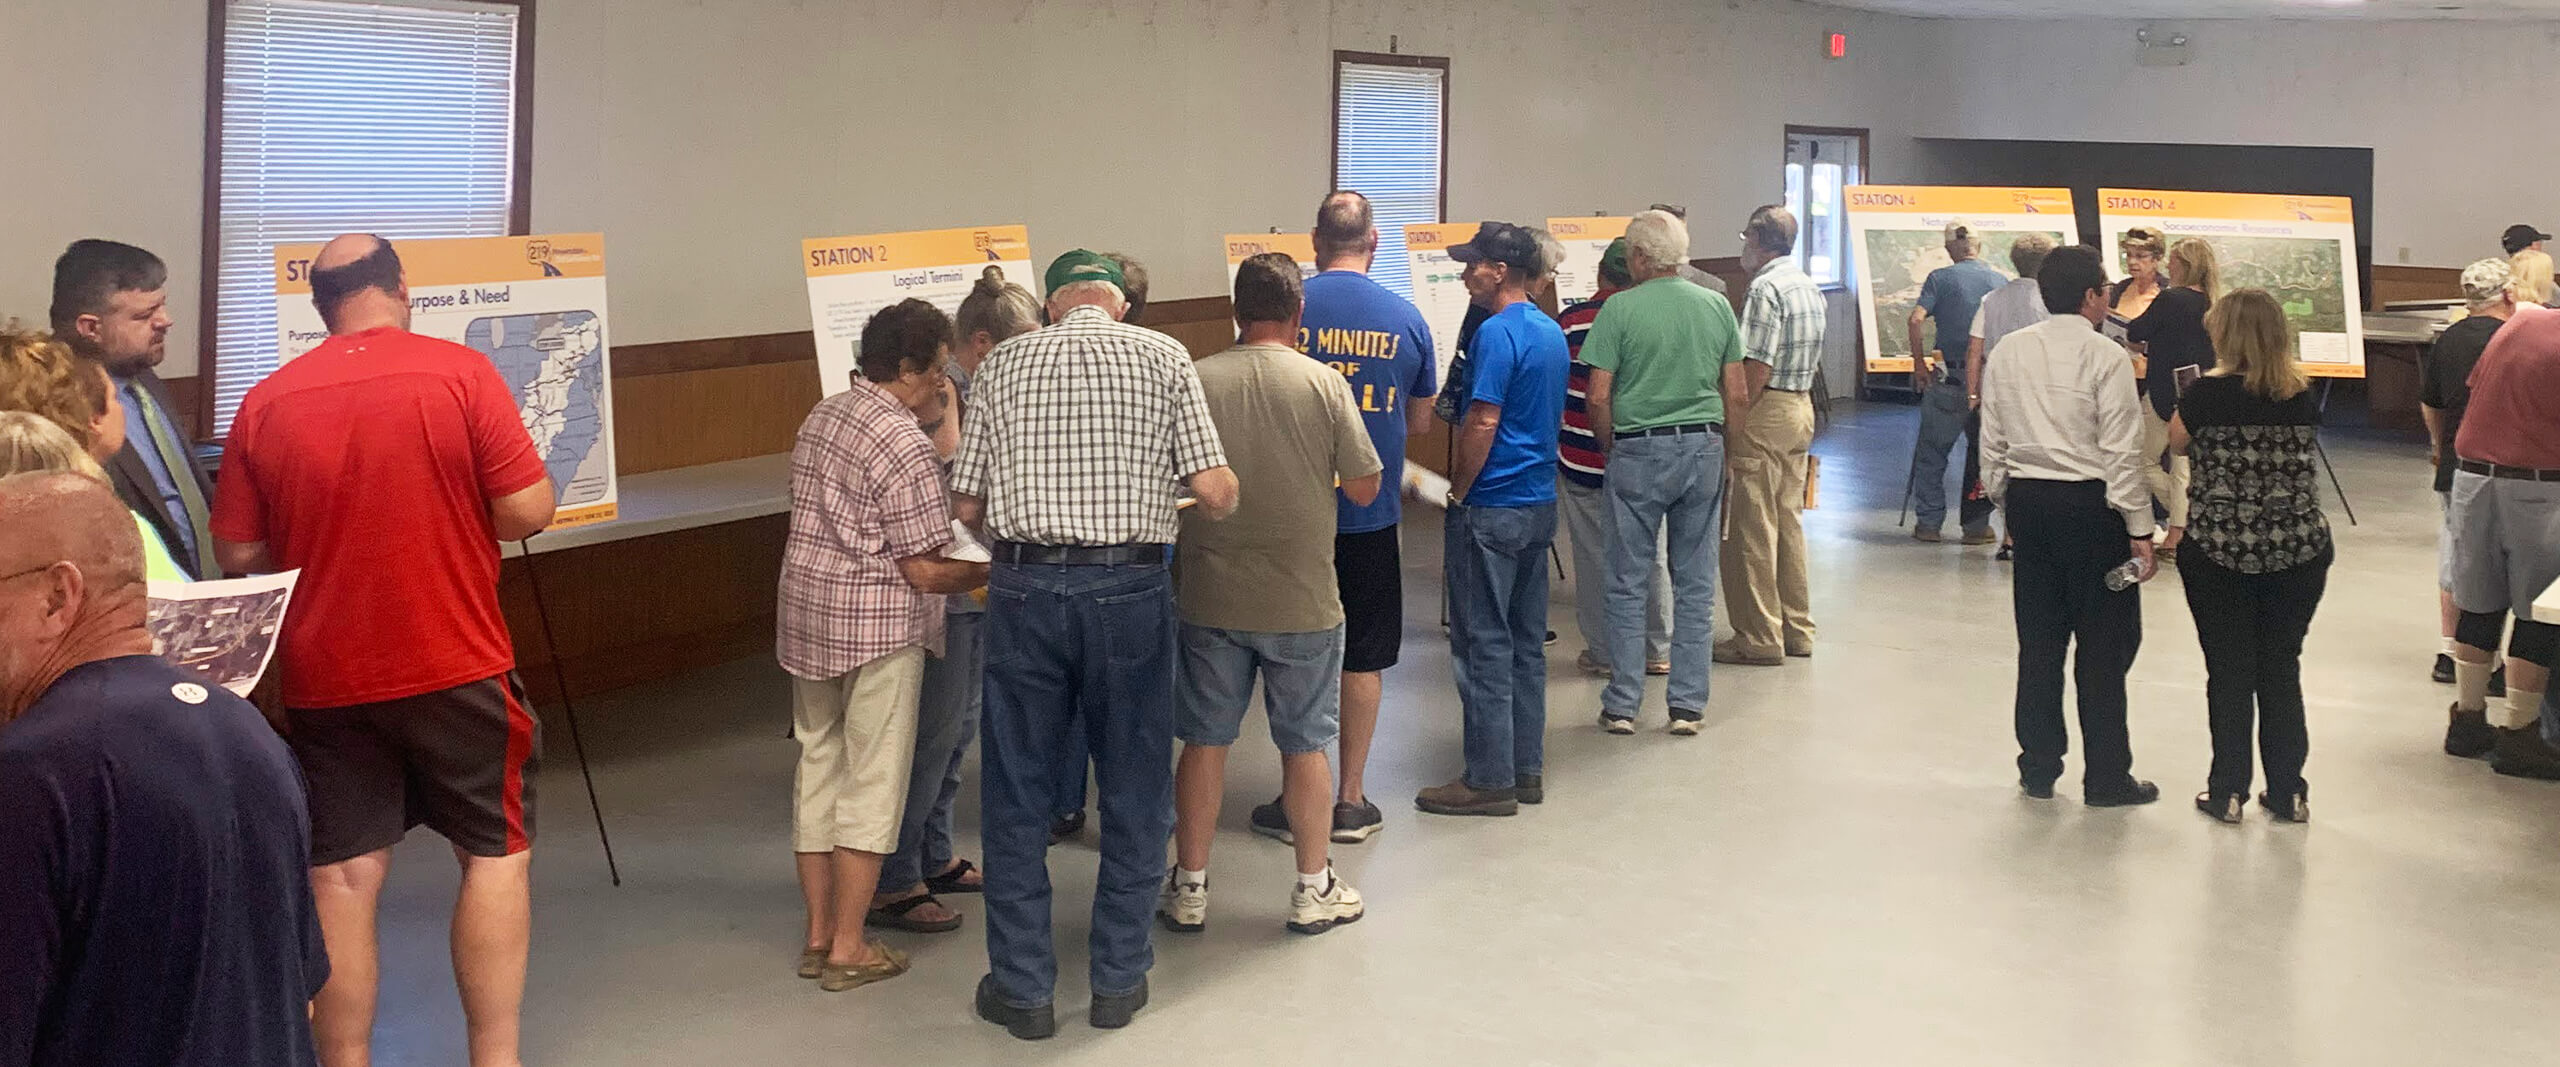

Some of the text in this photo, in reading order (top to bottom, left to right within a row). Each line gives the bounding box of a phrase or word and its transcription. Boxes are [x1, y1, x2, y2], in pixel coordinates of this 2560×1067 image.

[1852, 193, 1903, 206] STATION
[2106, 196, 2176, 210] STATION 4
[2163, 220, 2239, 233] Socioeconomic
[1408, 231, 1436, 244] STATION
[530, 245, 549, 261] 219
[811, 245, 888, 267] STATION 2
[893, 268, 963, 289] Logical Termini
[408, 284, 510, 312] urpose & Need
[1317, 326, 1401, 360] MINUTES
